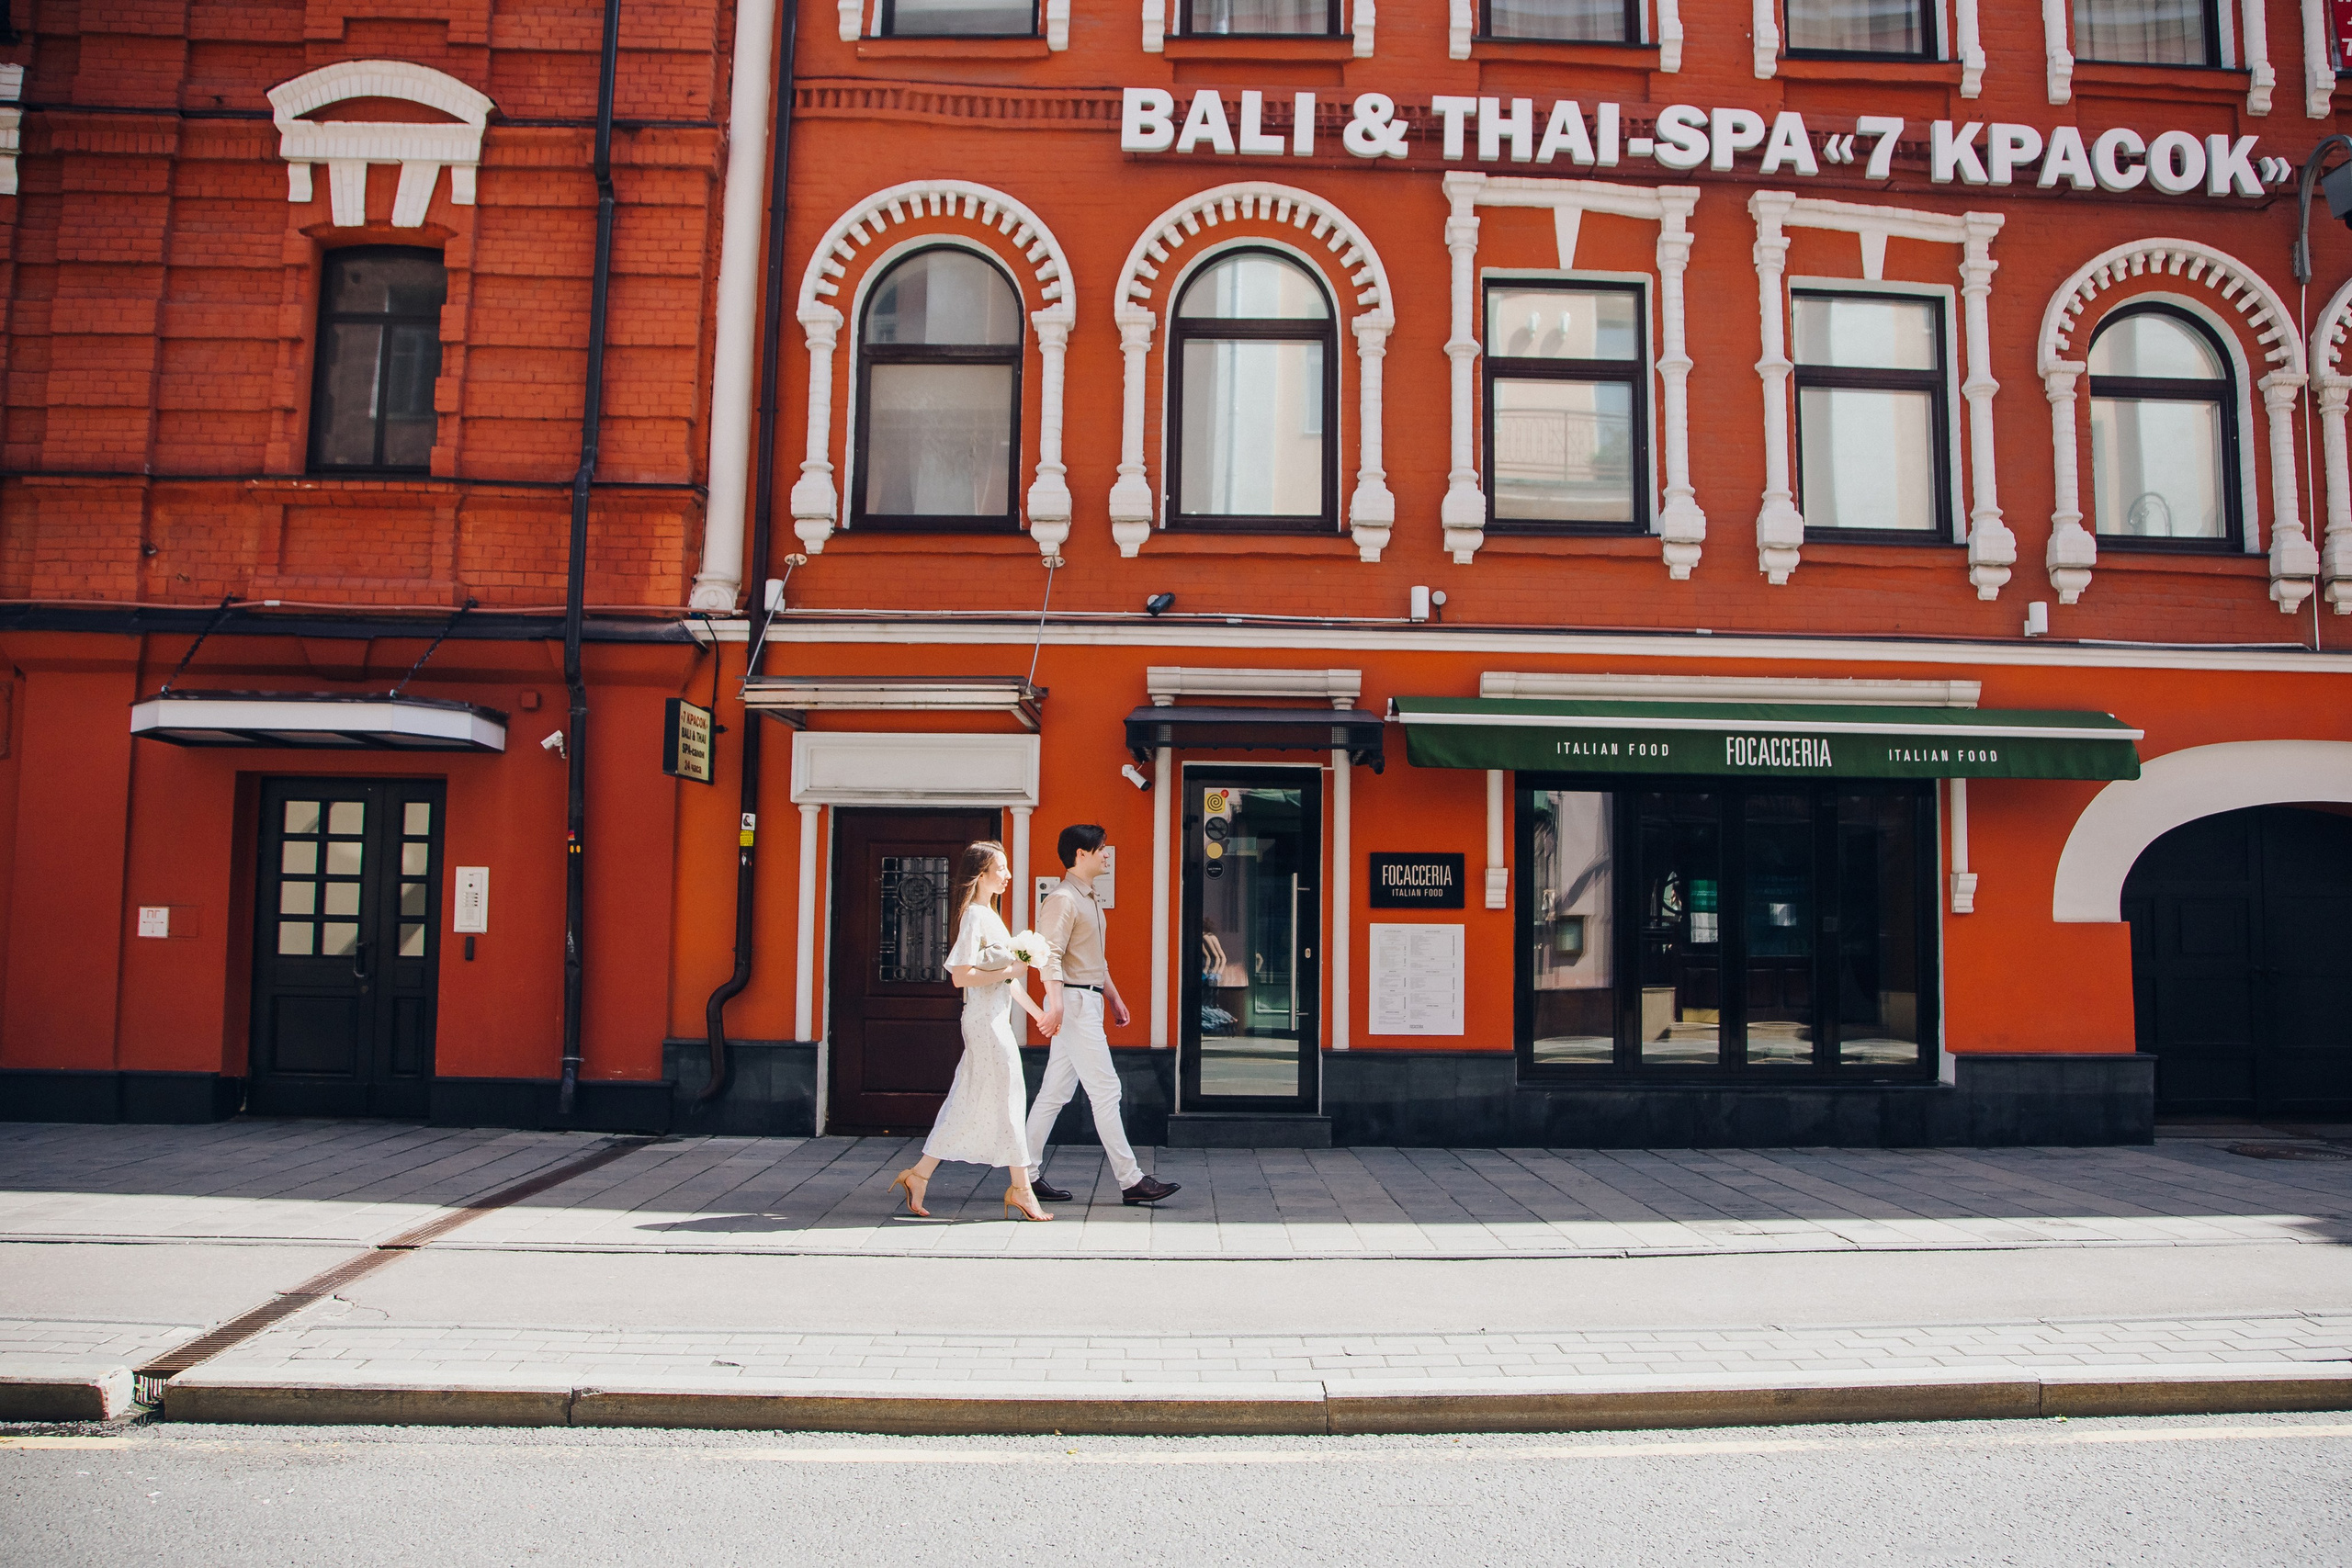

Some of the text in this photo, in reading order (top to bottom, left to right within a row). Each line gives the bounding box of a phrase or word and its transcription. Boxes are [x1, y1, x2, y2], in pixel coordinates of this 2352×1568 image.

[1121, 87, 2291, 198] BALI & THAI-SPA «7 КРАСОК»
[681, 727, 706, 745] BALI & THAI
[1557, 742, 1669, 756] ITALIAN FOOD
[1726, 737, 1832, 767] FOCACCERIA
[1888, 749, 1998, 762] ITALIAN FOOD
[684, 760, 701, 774] 24 часа
[1382, 865, 1452, 886] FOCACCERIA
[1392, 889, 1443, 897] ITALIAN FOOD
[147, 910, 160, 919] ПГ
